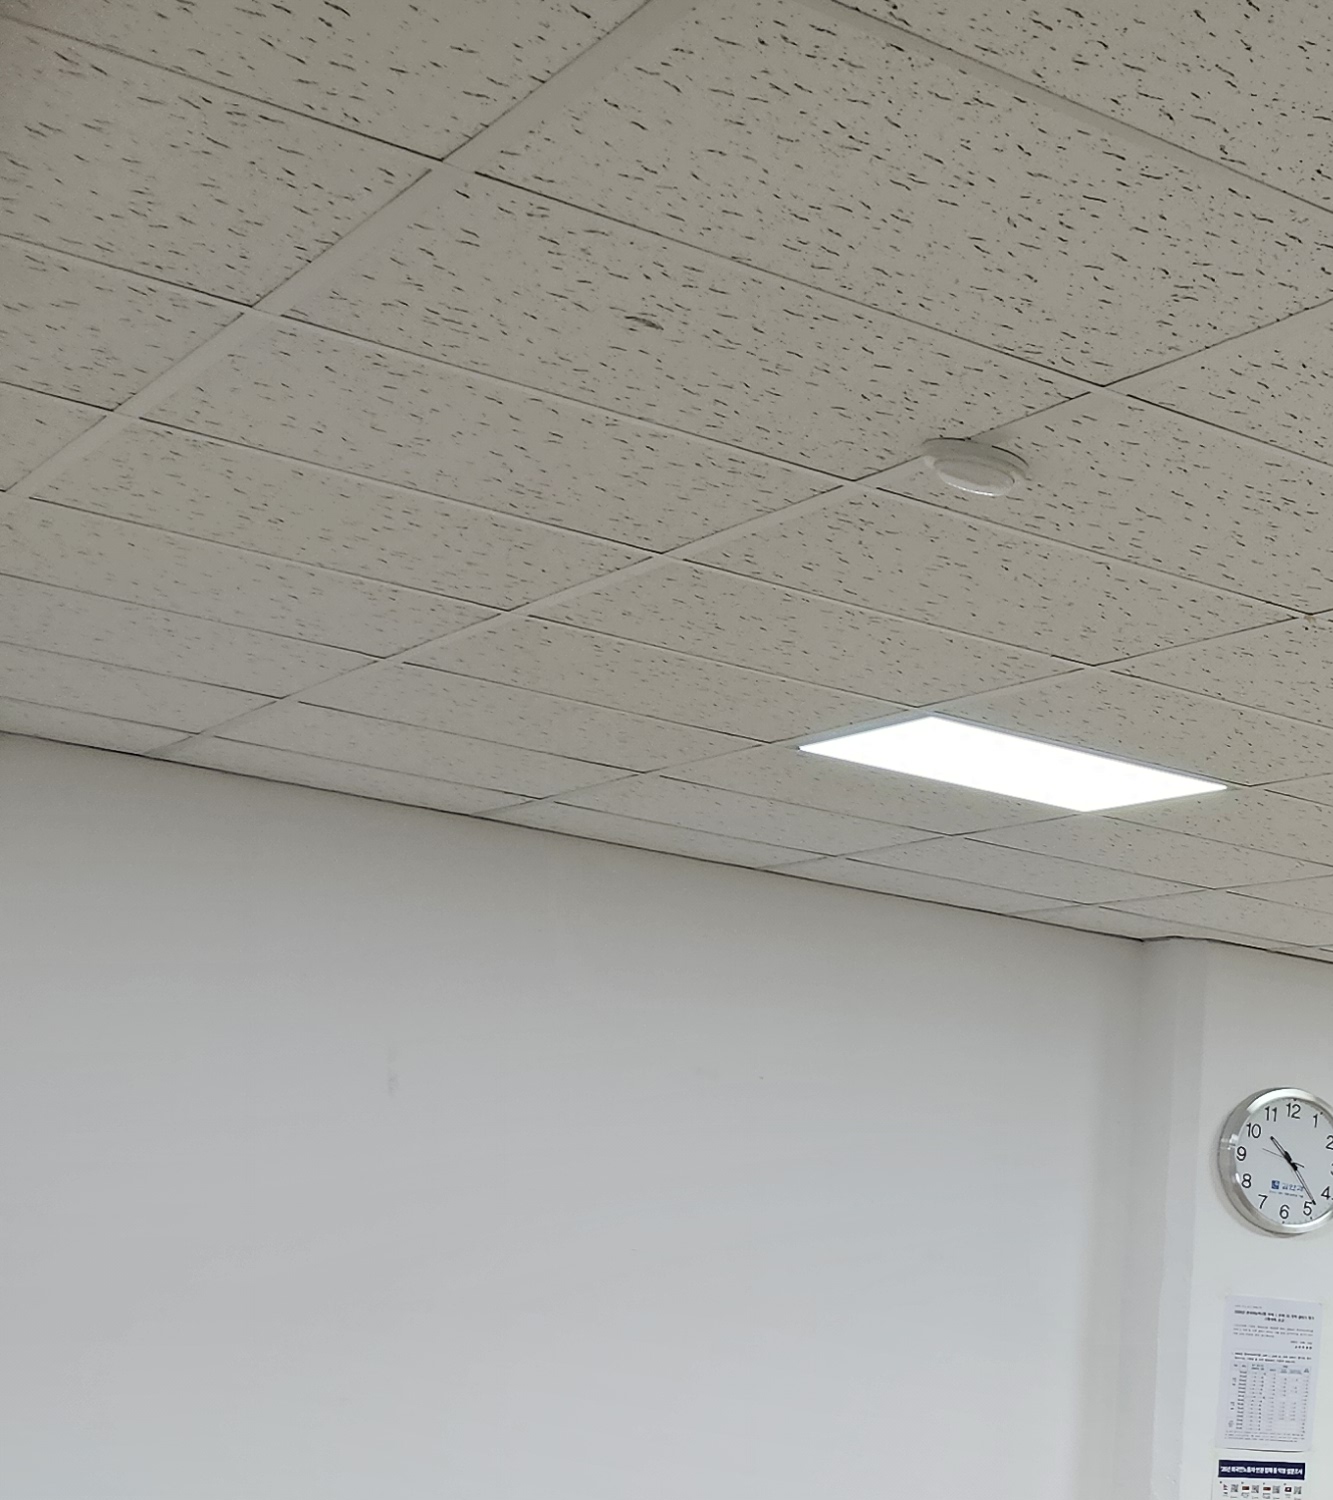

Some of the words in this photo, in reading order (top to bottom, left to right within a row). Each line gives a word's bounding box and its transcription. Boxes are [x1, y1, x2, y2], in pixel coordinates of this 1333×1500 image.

[1265, 1106, 1278, 1122] 11
[1286, 1103, 1301, 1119] 12
[1313, 1113, 1318, 1128] 1
[1246, 1123, 1261, 1138] 10
[1236, 1146, 1247, 1161] 9
[1241, 1174, 1251, 1188] 8
[1321, 1186, 1330, 1200] 4
[1258, 1194, 1268, 1209] 7
[1303, 1201, 1313, 1216] 5
[1279, 1204, 1289, 1219] 6
